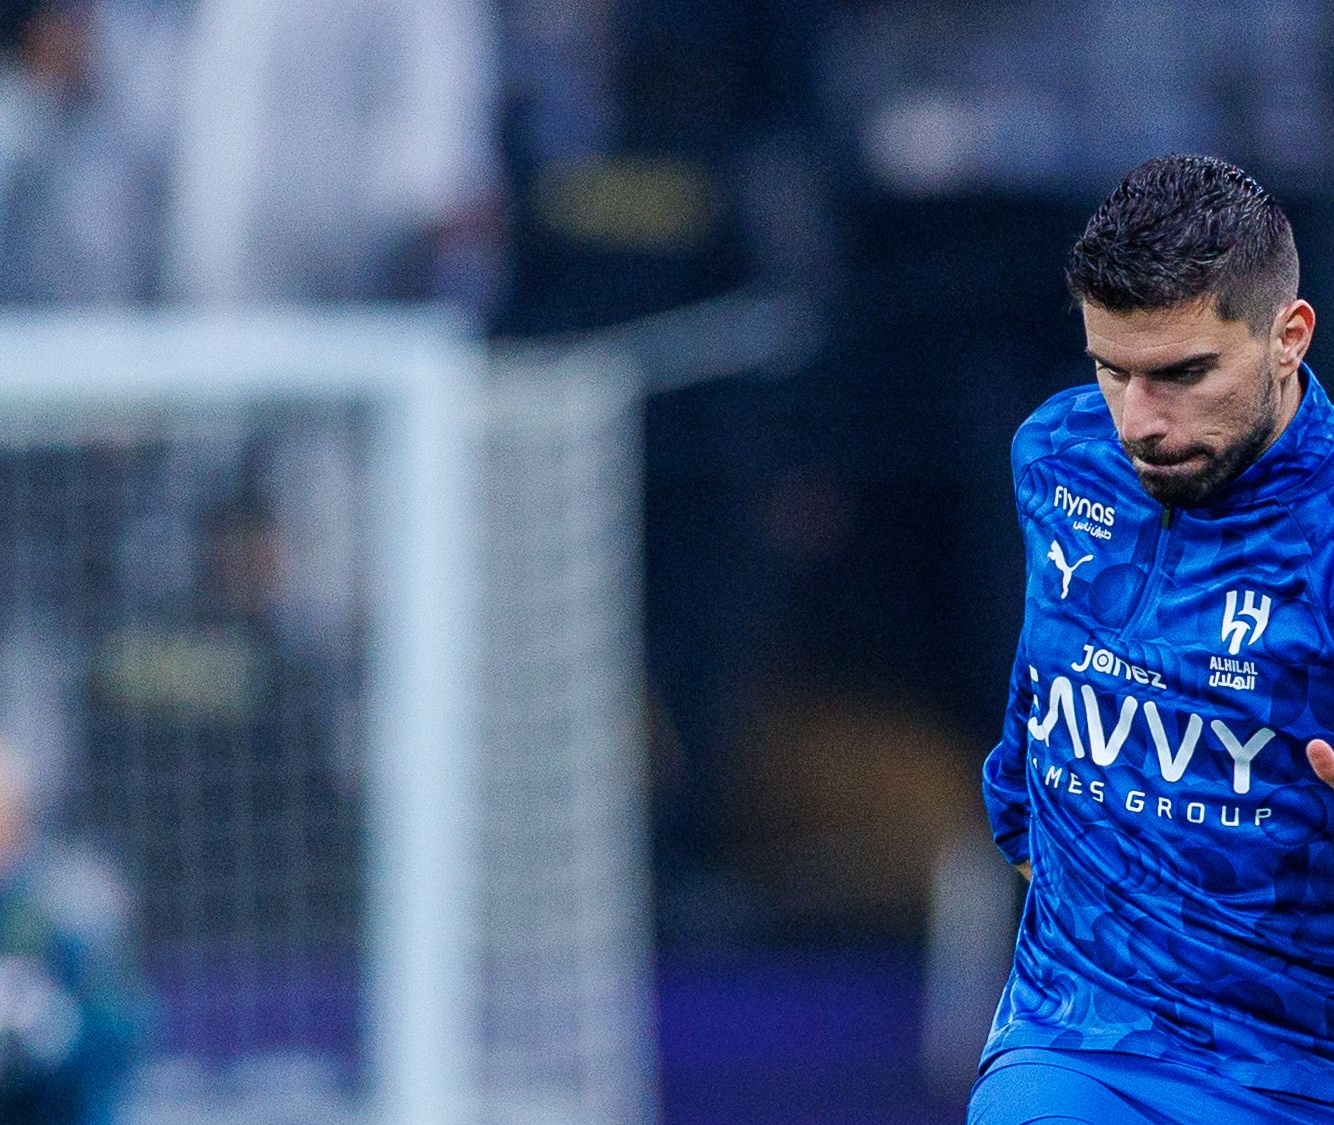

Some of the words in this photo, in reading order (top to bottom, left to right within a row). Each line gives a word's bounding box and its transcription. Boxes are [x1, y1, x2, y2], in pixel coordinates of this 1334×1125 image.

[1053, 485, 1116, 527] flynas
[1209, 655, 1258, 675] ALHILAL
[1208, 671, 1255, 691] الهلال
[1125, 789, 1272, 827] GROUP
